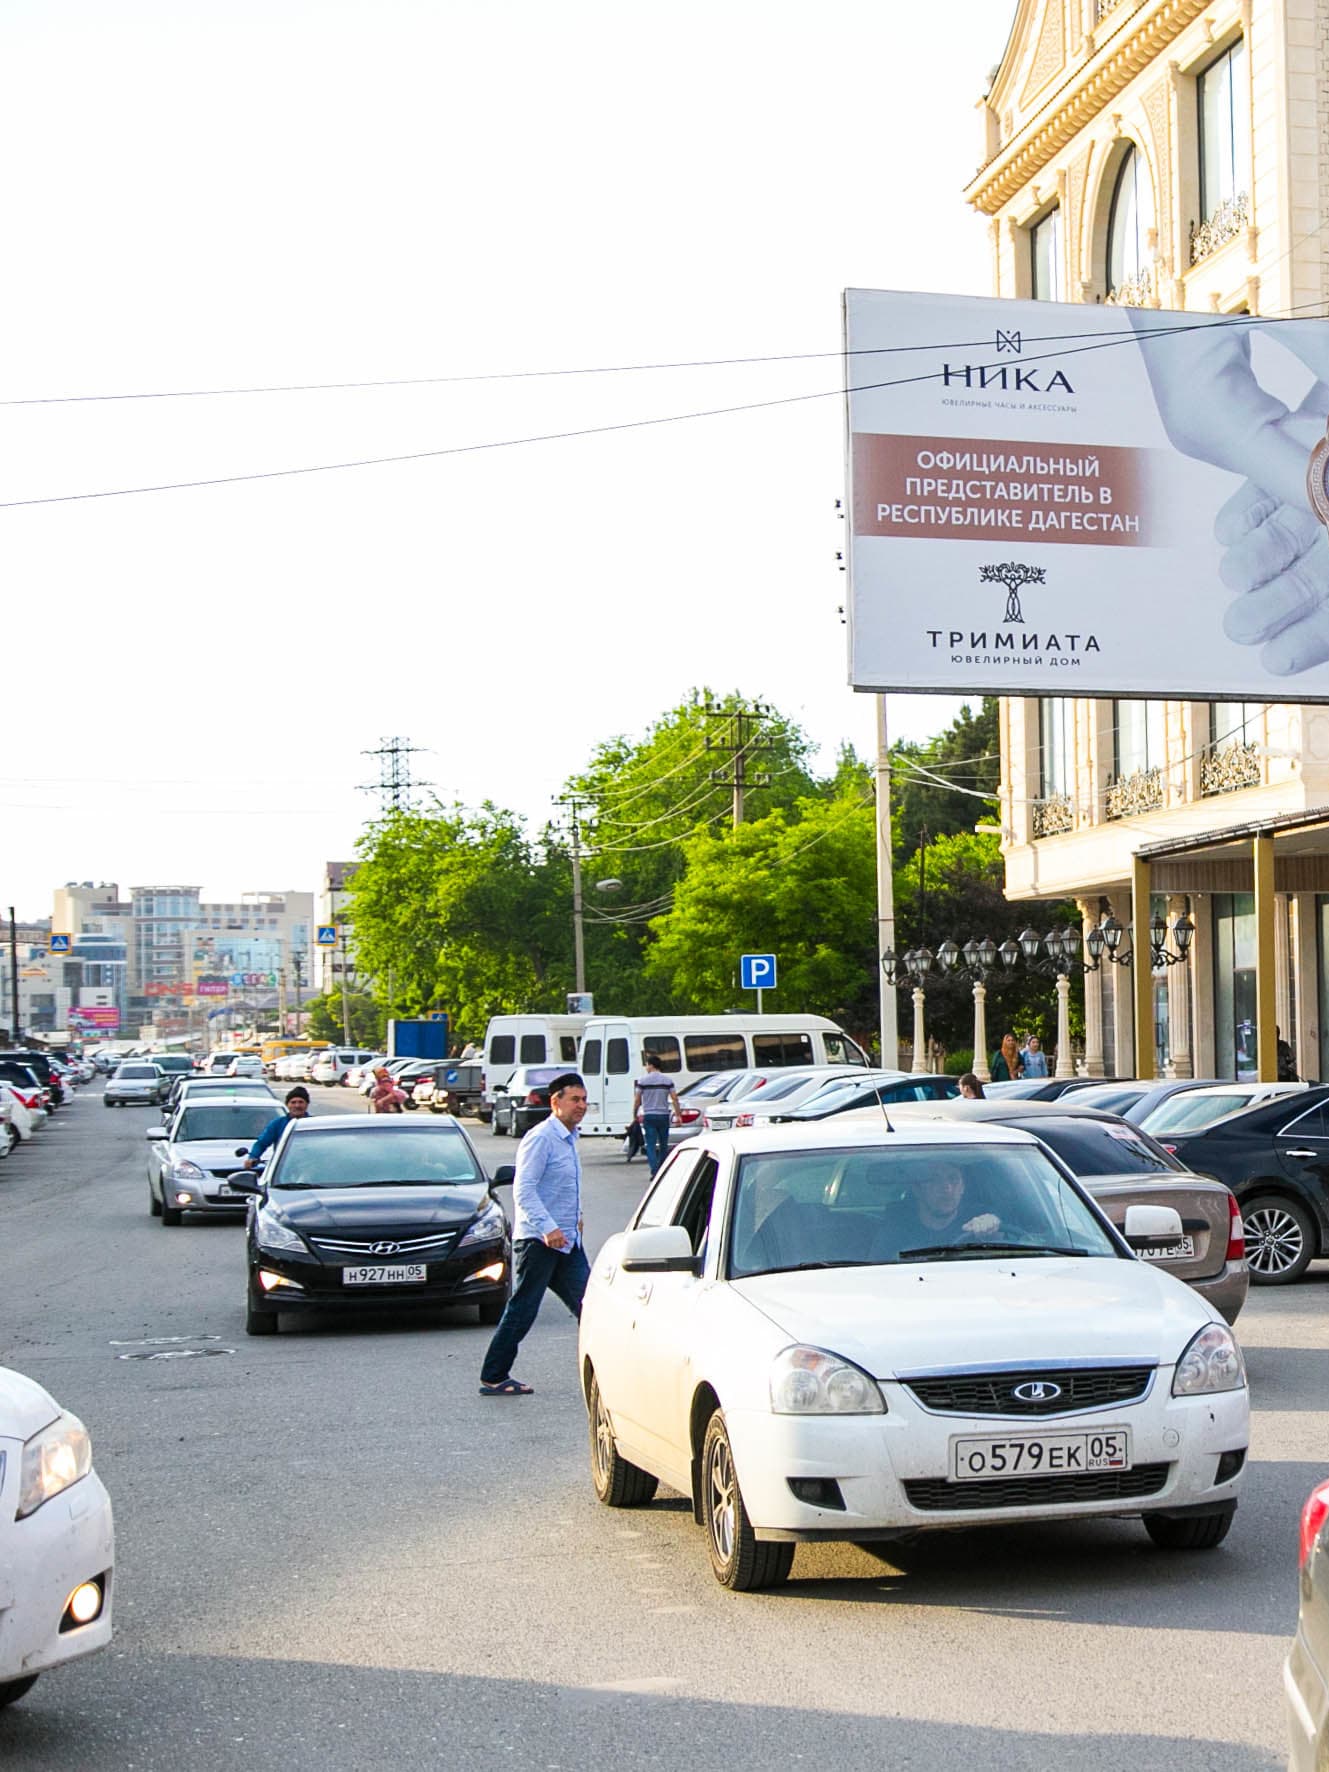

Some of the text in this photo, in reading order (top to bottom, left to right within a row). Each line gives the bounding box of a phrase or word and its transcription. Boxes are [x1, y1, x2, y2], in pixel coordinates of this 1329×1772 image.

[943, 363, 1075, 394] НИКА
[917, 450, 1099, 477] ОФИЦИАЛЬНЫЙ
[905, 477, 1112, 505] ПРЕДСТАВИТЕЛЬ В
[877, 503, 1139, 533] РЕСПУБЛИКЕ ДАГЕСТАН
[927, 631, 1100, 652] ТРИМИАТА
[951, 654, 1081, 666] ЮВЕЛИРНЫЙ ДОМ
[751, 959, 769, 985] P
[407, 1266, 422, 1276] 05
[1091, 1436, 1118, 1459] 05
[1089, 1459, 1109, 1467] RUS
